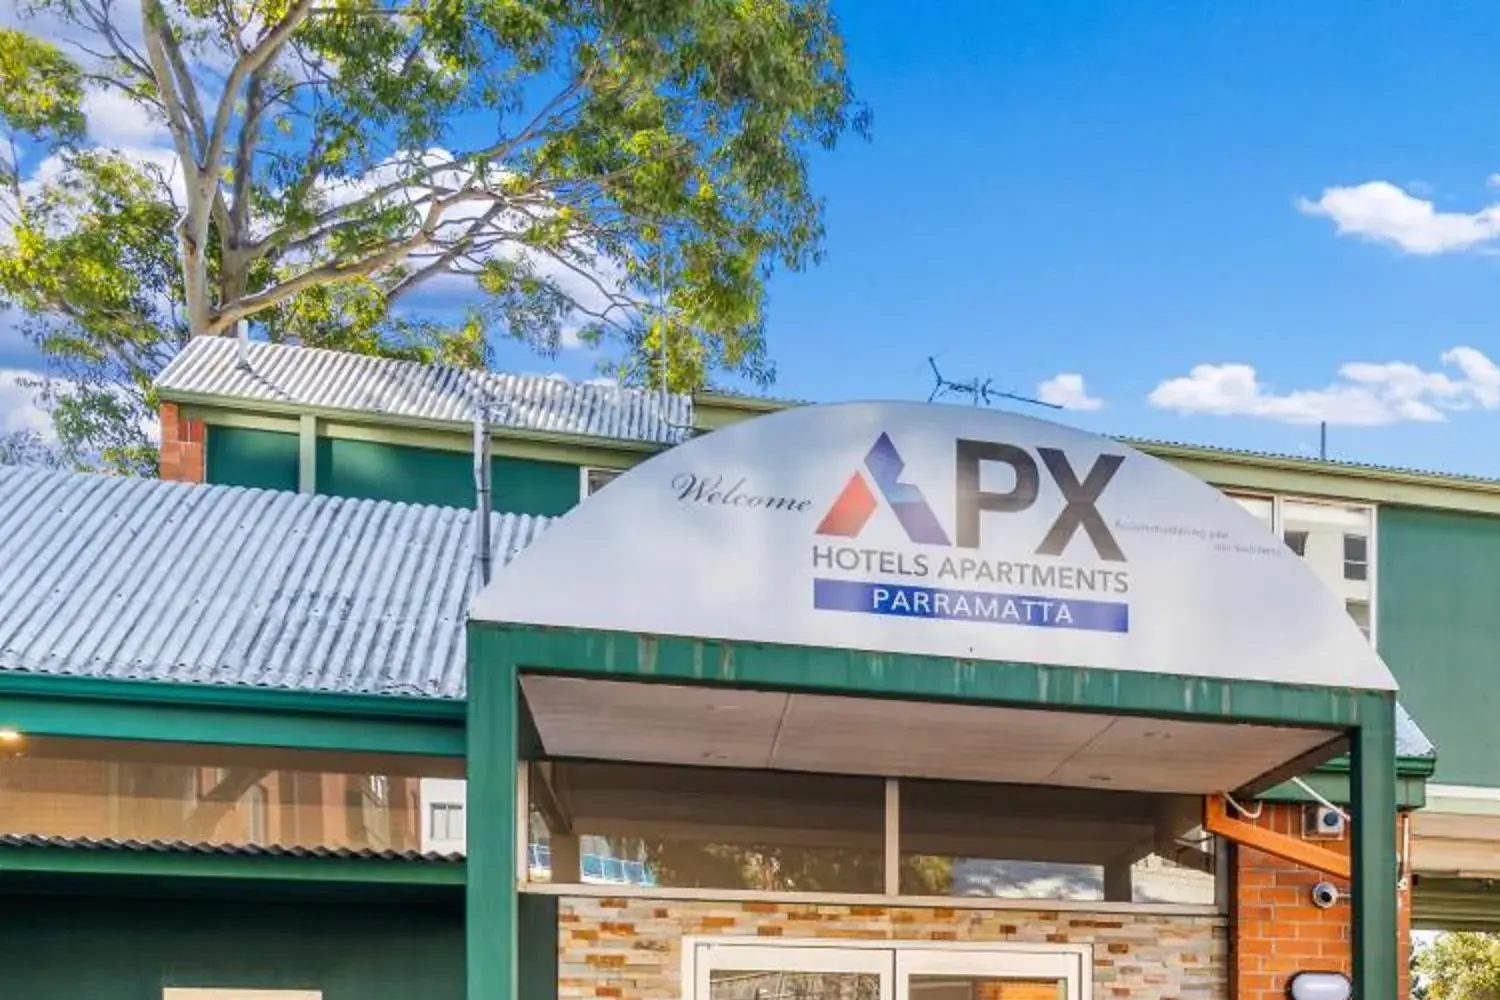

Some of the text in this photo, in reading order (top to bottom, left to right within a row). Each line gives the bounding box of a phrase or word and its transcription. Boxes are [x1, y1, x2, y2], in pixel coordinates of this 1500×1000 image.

[671, 472, 814, 512] Welcome
[815, 431, 1127, 562] APX
[813, 546, 1129, 593] HOTELS APARTMENTS
[872, 589, 1074, 624] PARRAMATTA
